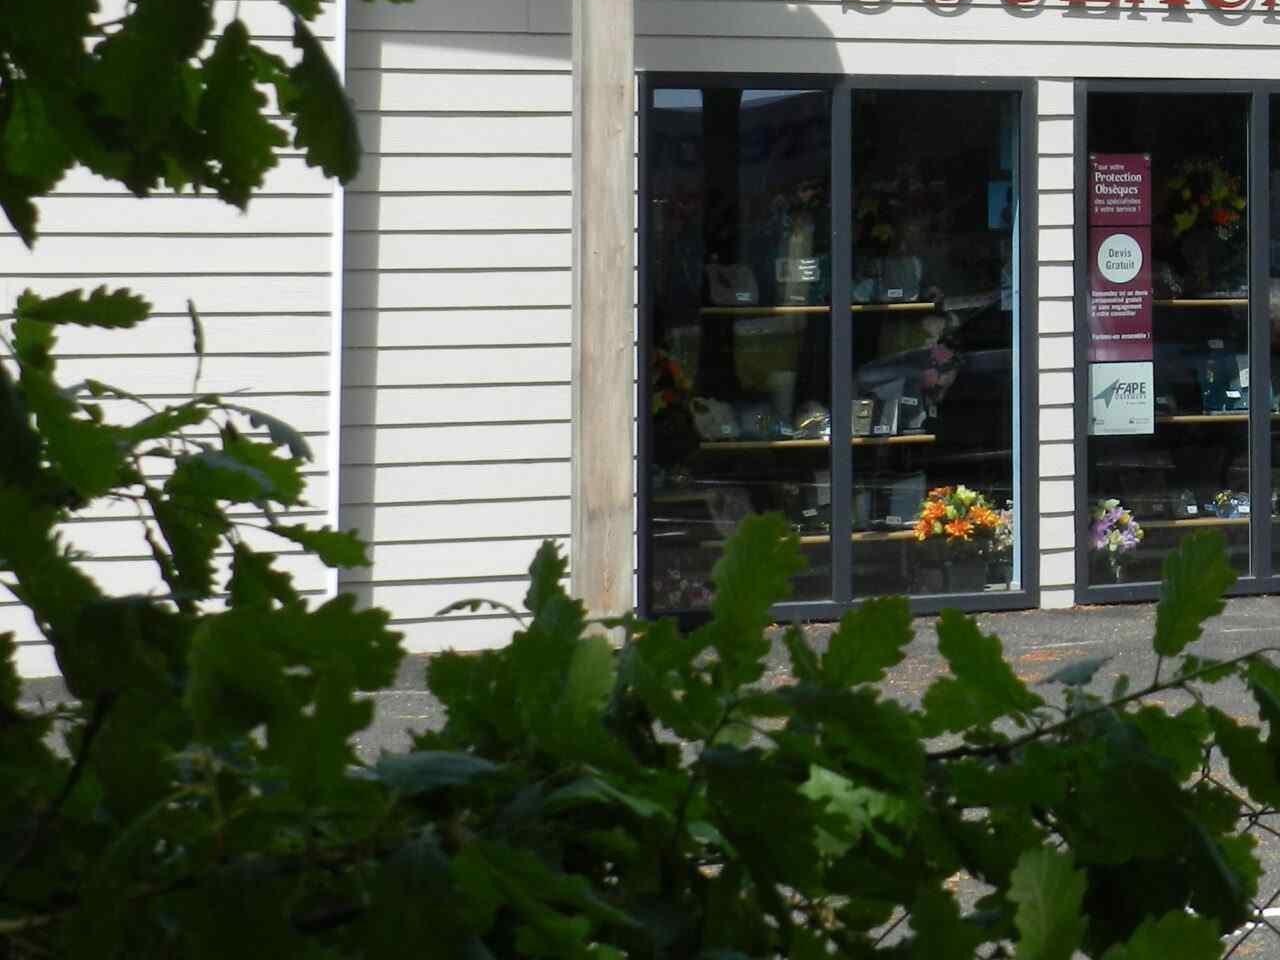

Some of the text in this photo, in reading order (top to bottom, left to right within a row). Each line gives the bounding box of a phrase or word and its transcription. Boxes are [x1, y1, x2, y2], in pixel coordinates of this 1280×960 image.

[1094, 171, 1142, 183] Protection
[1094, 183, 1139, 197] Obsèques
[1108, 247, 1132, 258] Devis
[1105, 260, 1135, 271] Gratuit
[1115, 381, 1147, 395] FAPE
